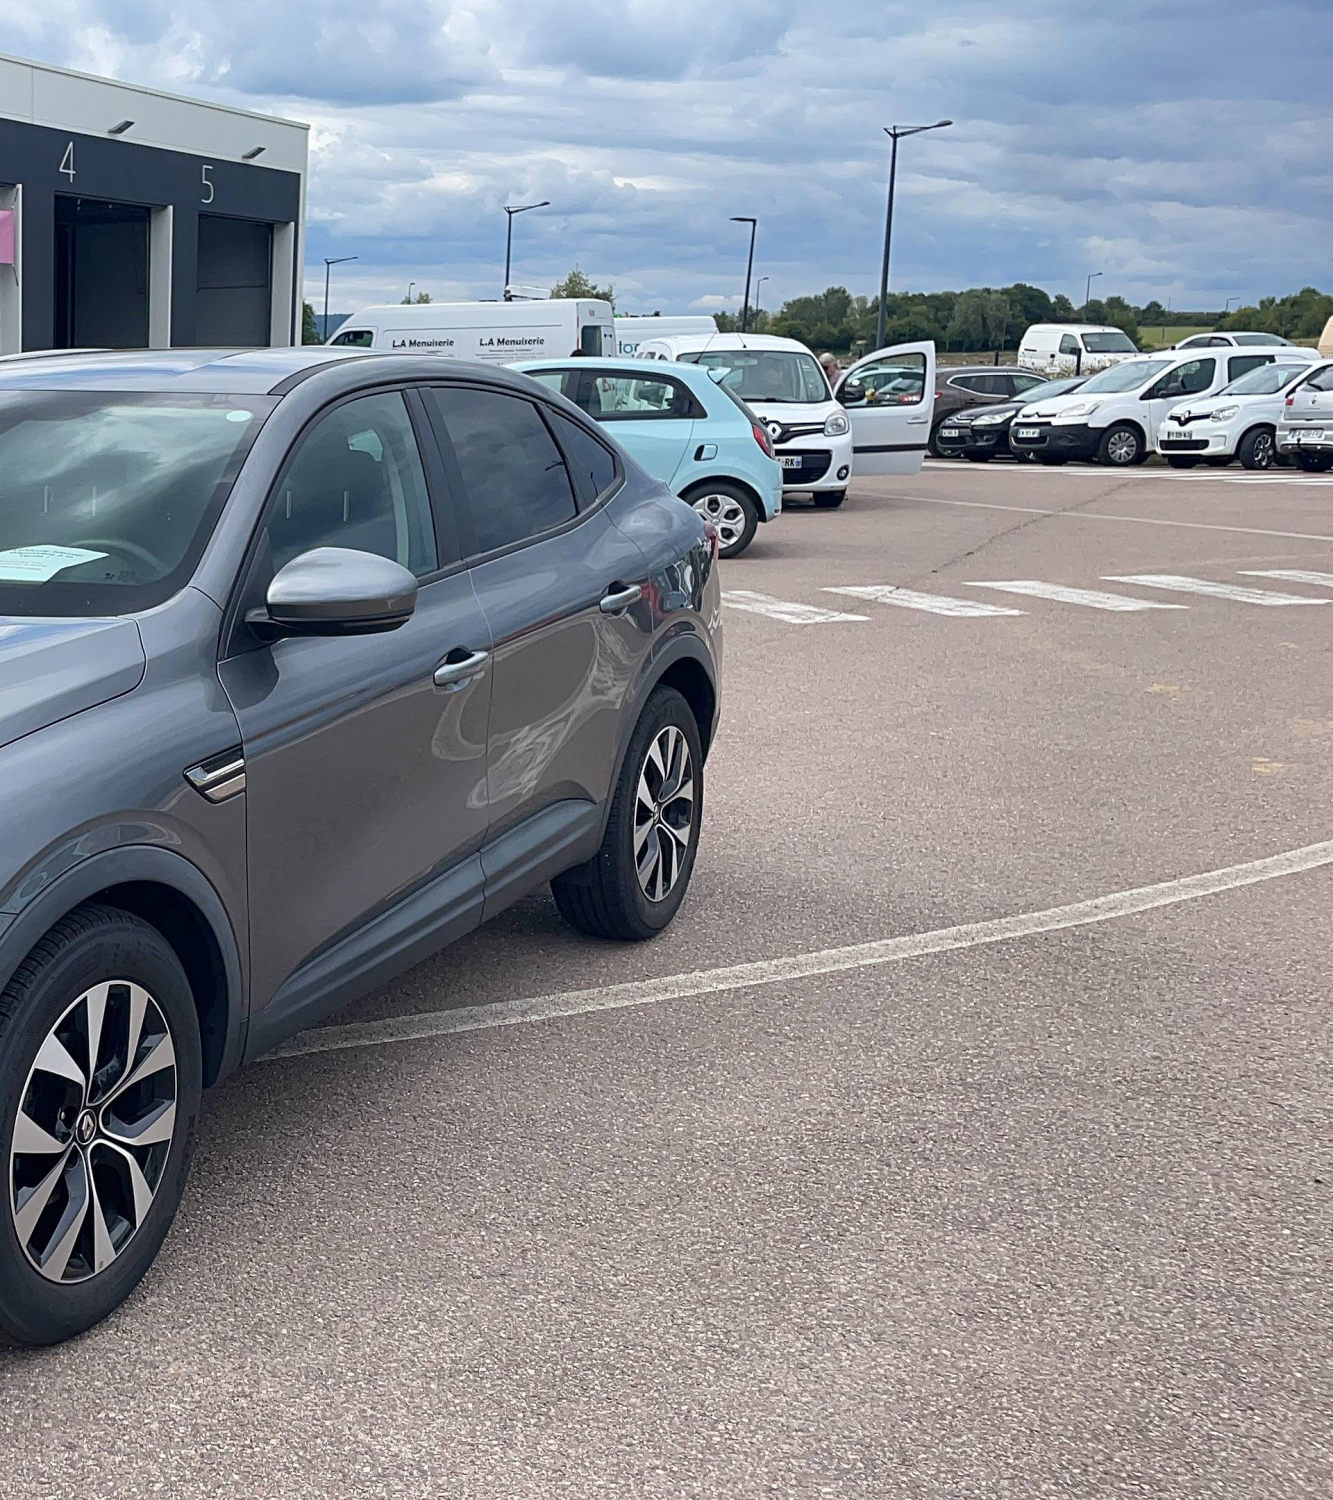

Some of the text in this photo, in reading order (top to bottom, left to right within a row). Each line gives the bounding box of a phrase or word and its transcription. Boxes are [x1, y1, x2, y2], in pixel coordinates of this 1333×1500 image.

[59, 141, 76, 183] 4
[201, 165, 215, 203] 5
[392, 338, 455, 348] L.A Menuiserie
[479, 336, 545, 346] L.A Menuiserie
